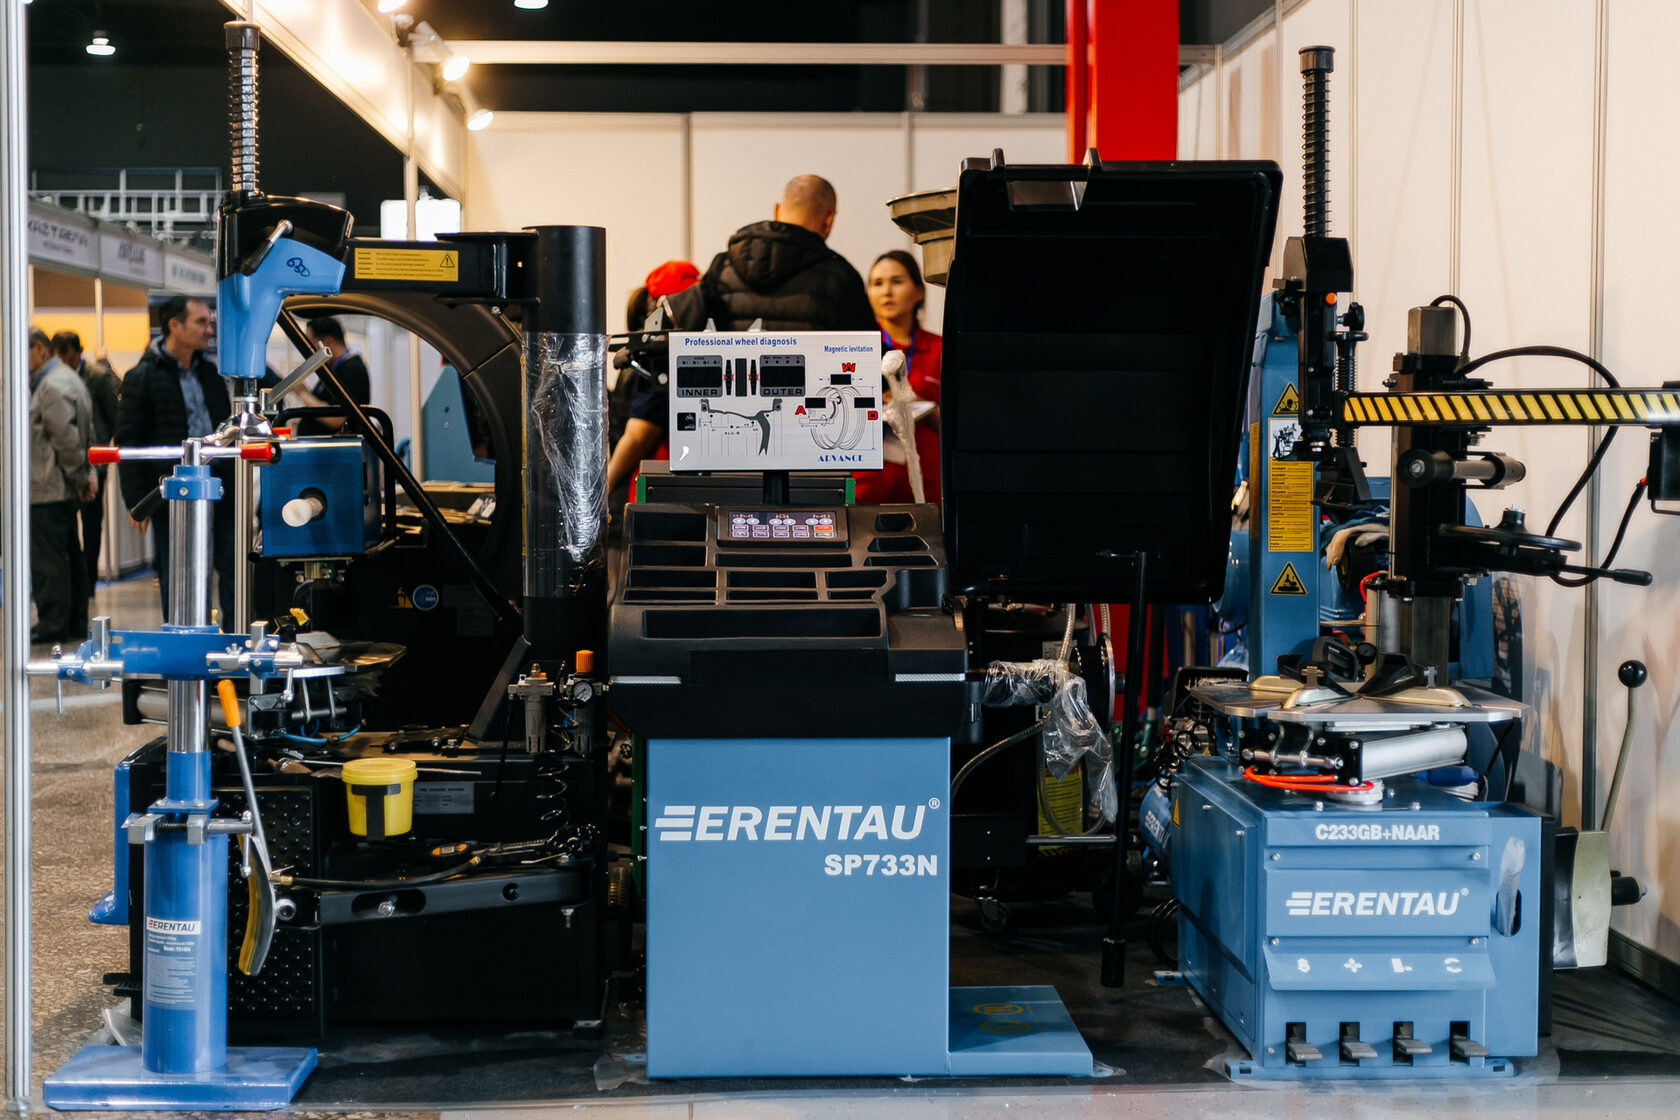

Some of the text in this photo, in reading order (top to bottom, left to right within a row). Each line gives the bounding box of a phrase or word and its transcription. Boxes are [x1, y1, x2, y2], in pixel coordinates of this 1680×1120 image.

[684, 337, 797, 347] Professional wheel diagnosis
[823, 345, 873, 354] Magnetic levitation
[841, 362, 856, 373] W
[763, 388, 803, 396] OUTER
[795, 405, 807, 416] A
[867, 411, 879, 421] D
[1315, 824, 1440, 840] C233GB+NAAR
[824, 854, 938, 876] SP733N
[152, 920, 196, 932] ERENTAU
